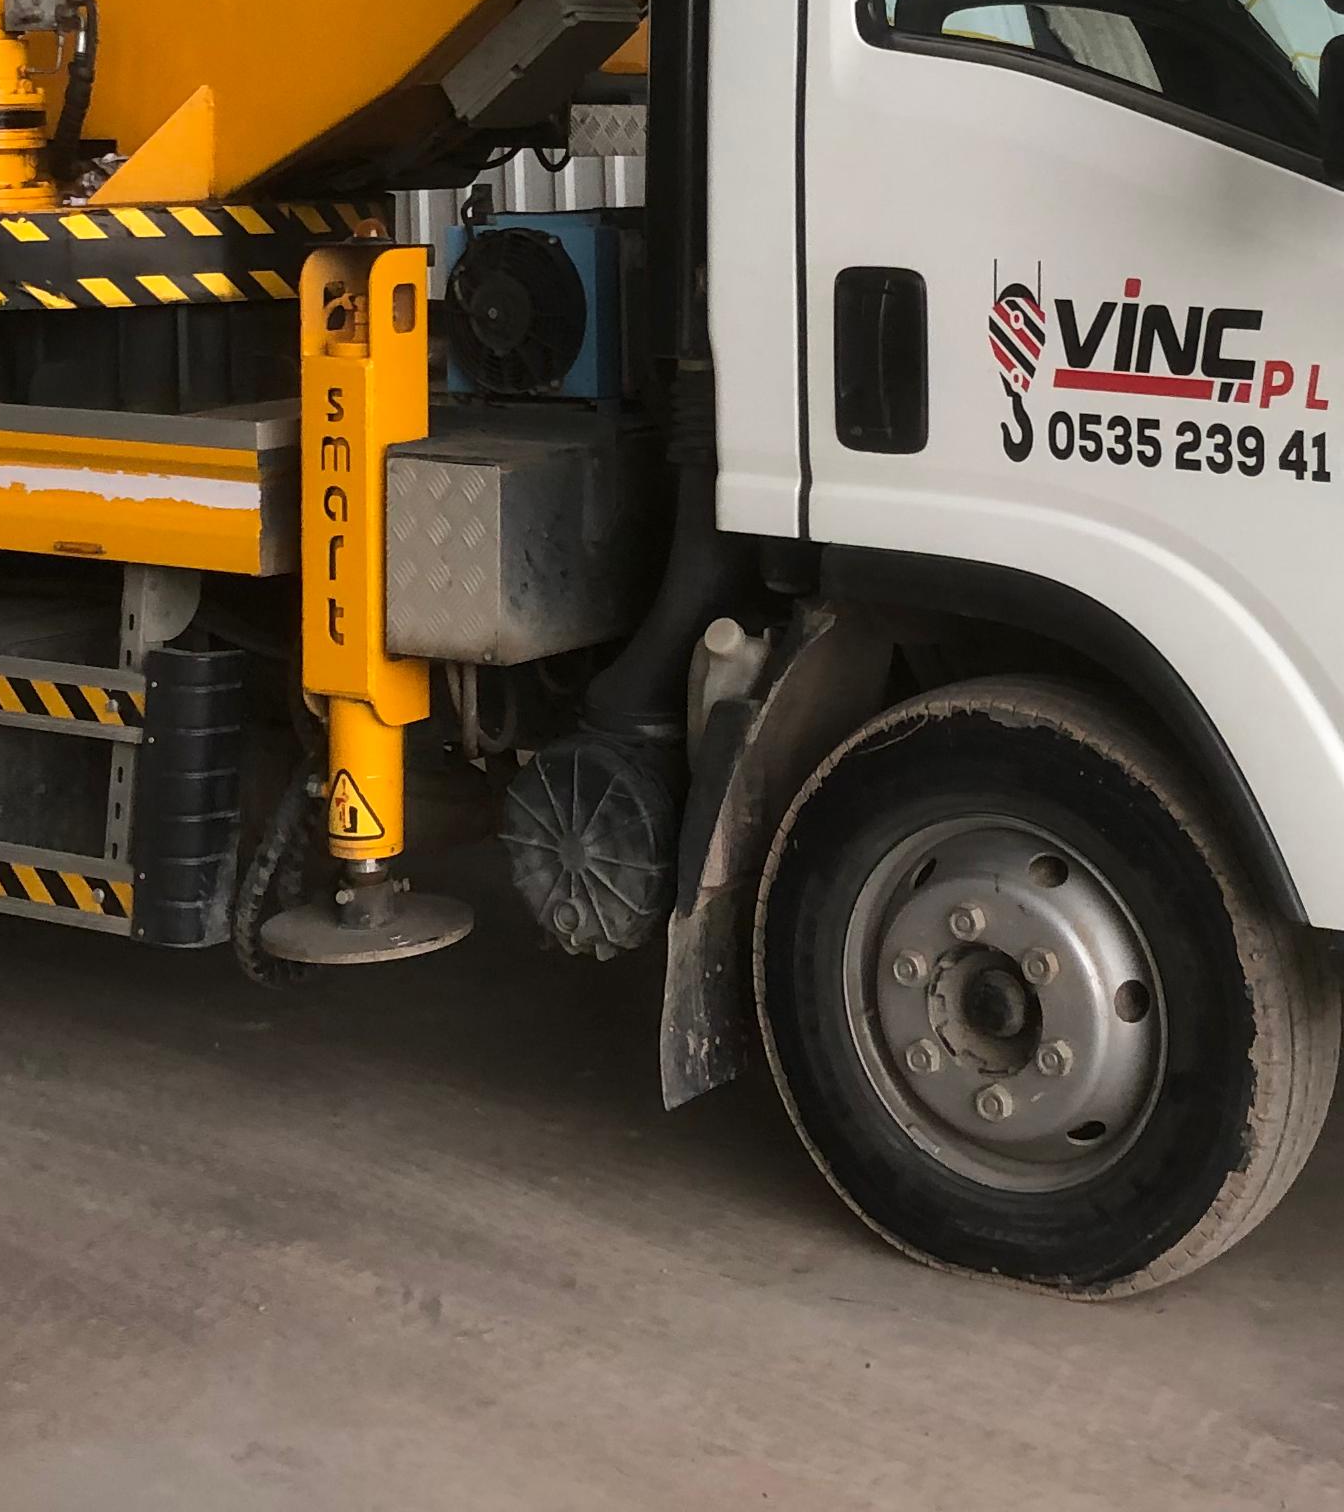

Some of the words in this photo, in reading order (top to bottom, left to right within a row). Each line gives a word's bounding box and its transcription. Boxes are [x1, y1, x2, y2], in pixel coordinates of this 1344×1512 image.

[321, 386, 351, 646] smart
[1048, 410, 1162, 468] 0535
[1175, 420, 1266, 477] 239
[1278, 430, 1332, 483] 41
